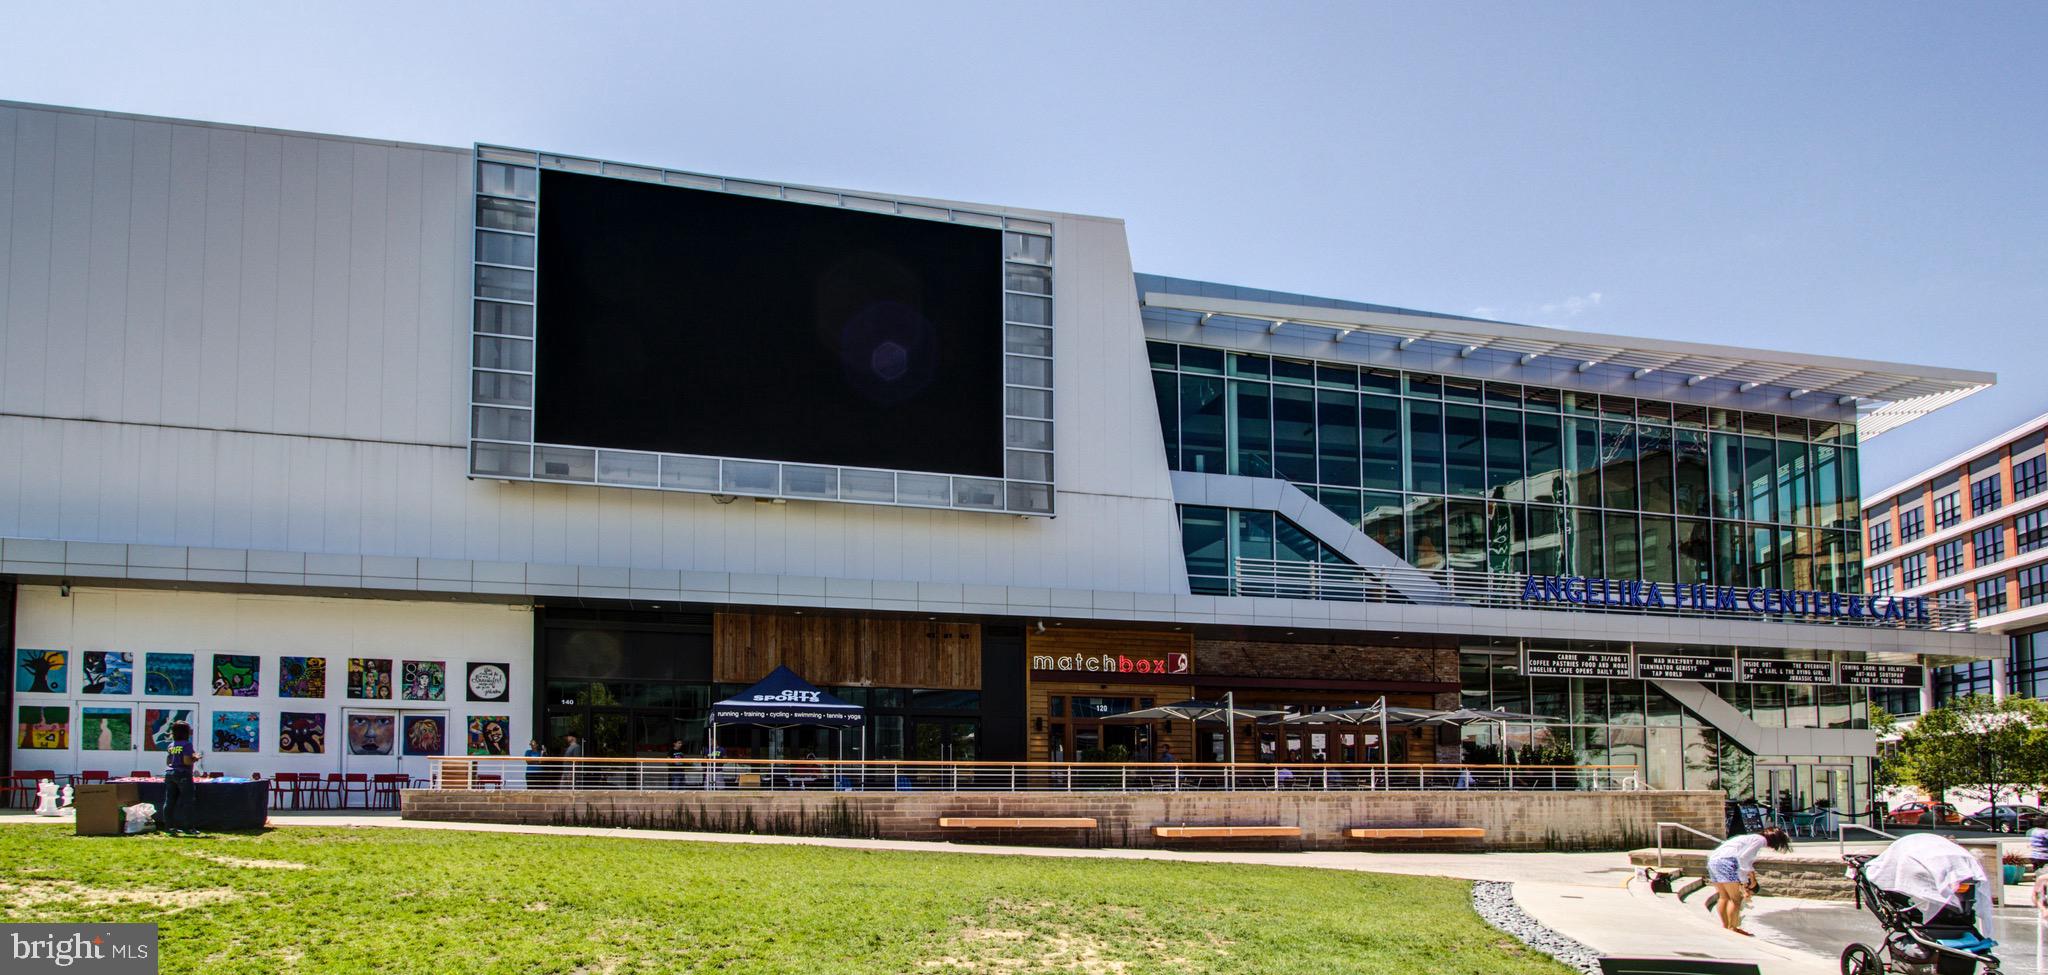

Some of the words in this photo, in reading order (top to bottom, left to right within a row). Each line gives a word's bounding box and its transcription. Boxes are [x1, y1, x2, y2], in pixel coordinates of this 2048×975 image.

[1521, 575, 1665, 608] ANGELIKA
[1675, 582, 1739, 611] FILM
[1747, 587, 1843, 618] CENTER
[1848, 595, 1865, 618] &
[1868, 595, 1930, 622] CAFE
[1033, 652, 1166, 674] matchbox
[781, 689, 822, 698] CITY
[753, 694, 820, 703] SPORTS
[717, 710, 740, 718] running
